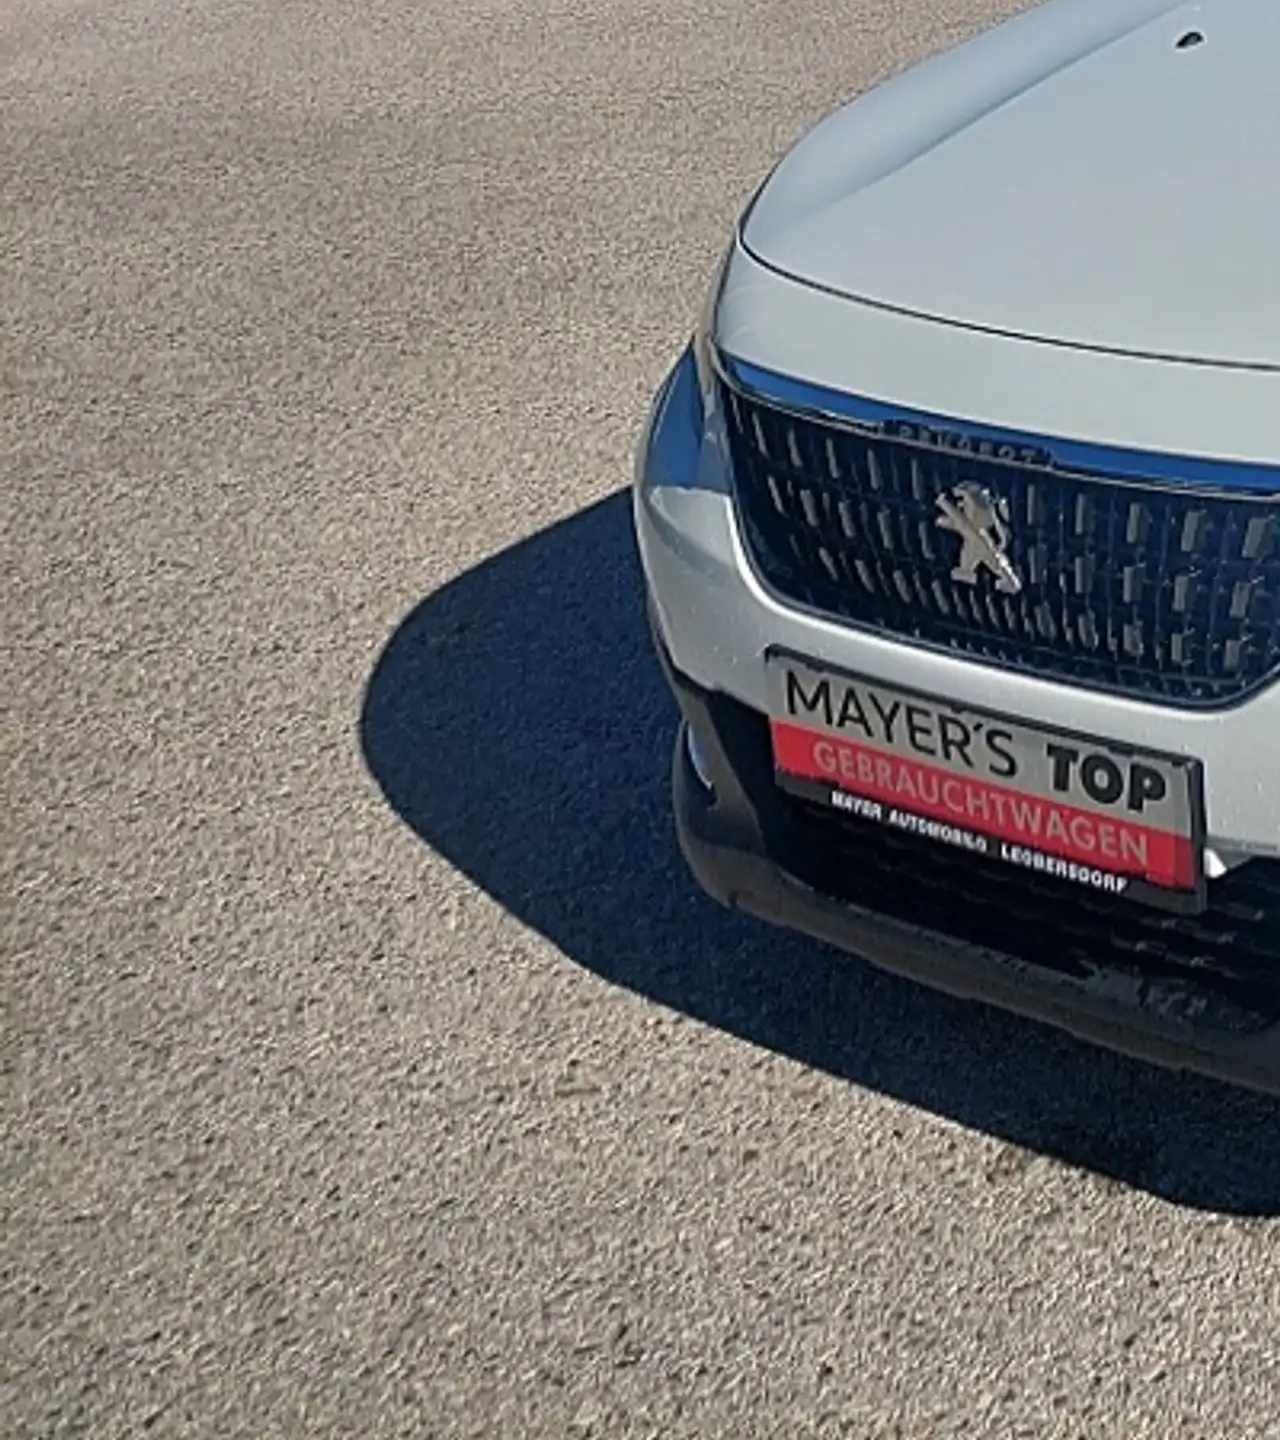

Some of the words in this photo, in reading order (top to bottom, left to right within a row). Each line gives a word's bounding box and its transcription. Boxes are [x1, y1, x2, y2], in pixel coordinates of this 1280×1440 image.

[785, 668, 1018, 778] MAYER'S
[1046, 744, 1168, 814] TOP
[811, 739, 1148, 867] GEBRAUCHTWAGEN
[831, 789, 883, 822] MAYER
[1000, 841, 1129, 894] LEOBERSDORF
